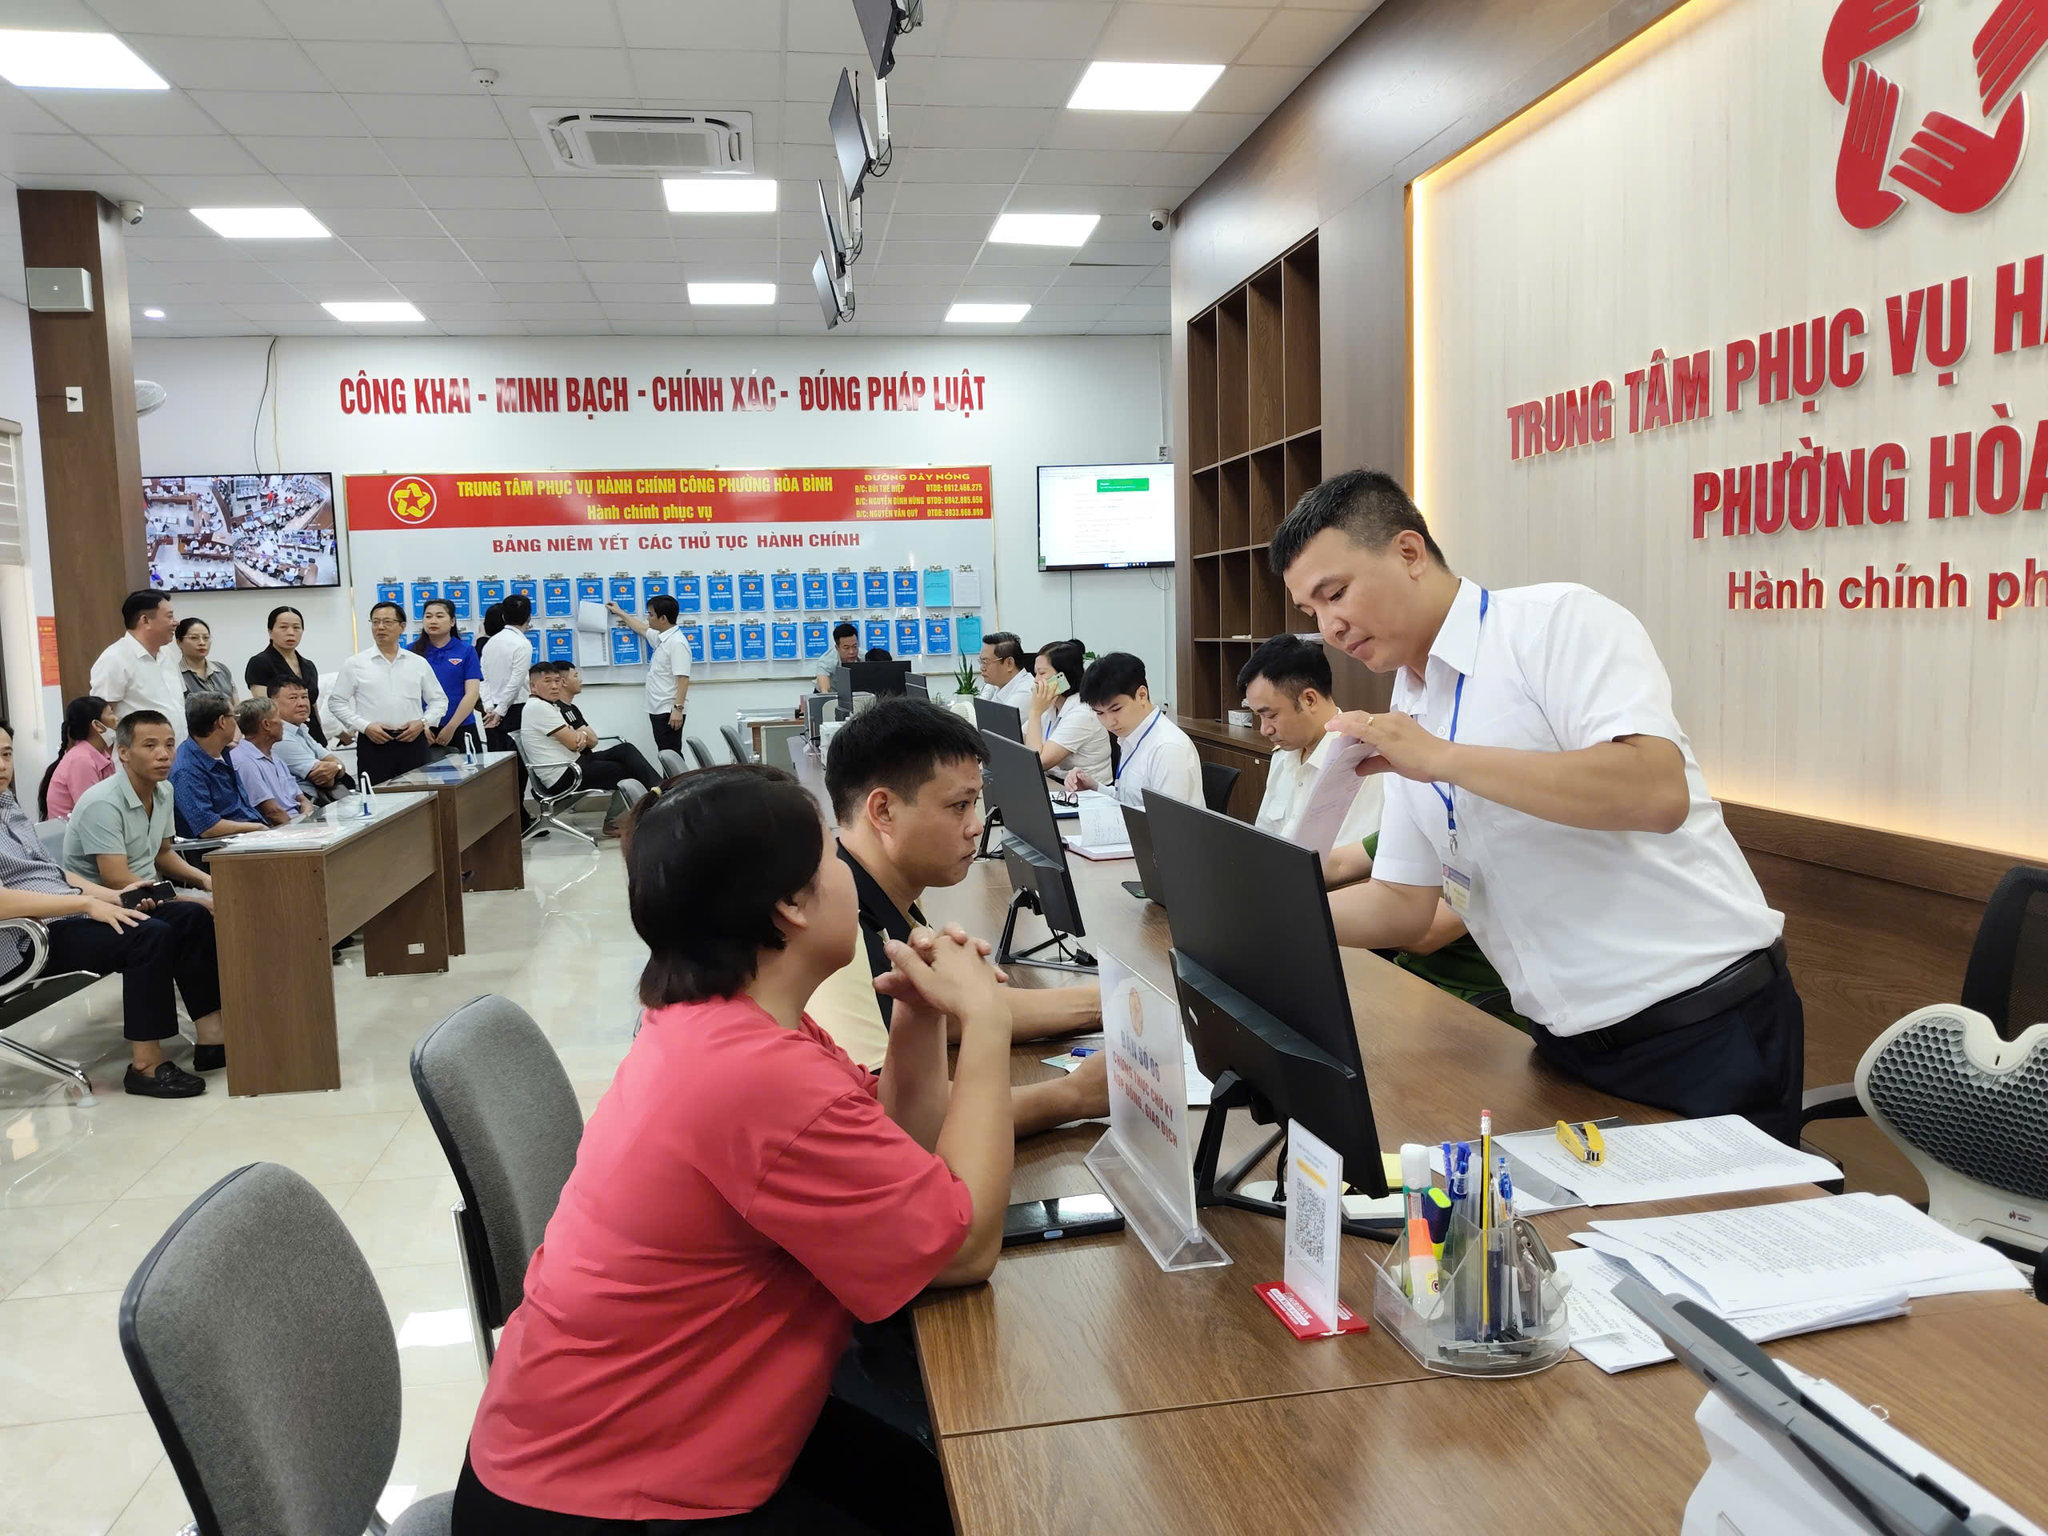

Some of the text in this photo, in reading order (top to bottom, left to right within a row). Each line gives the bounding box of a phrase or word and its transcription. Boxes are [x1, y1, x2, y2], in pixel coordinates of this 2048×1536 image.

[1506, 253, 2048, 462] TRUNG TÂM PHỤC VỤ H
[339, 369, 407, 415] CÔNG
[414, 377, 471, 414] KHAI
[495, 377, 559, 413] MINH
[566, 377, 629, 420] BẠCH
[652, 368, 724, 412] CHÍNH
[730, 368, 777, 412] XÁC
[799, 368, 860, 412] ĐÚNG
[868, 371, 926, 411] PHÁP
[933, 368, 986, 418] LUẬT
[456, 473, 833, 499] TRUNG TÂM PHỤC VỤ HÀNH CHÍNH CÔNG PHƯỜNG HÒA BÌNH
[864, 473, 970, 481] ĐƯỜNG DÂY NÓNG
[1692, 437, 1910, 540] PHƯỜNG
[587, 504, 713, 522] Hành chính phục vụ
[492, 530, 860, 553] BẢNG NIÊM YẾT CÁC THỦ TỤC HÀNH CHÍNH
[1727, 567, 1827, 610] Hành
[1838, 561, 1971, 609] chính
